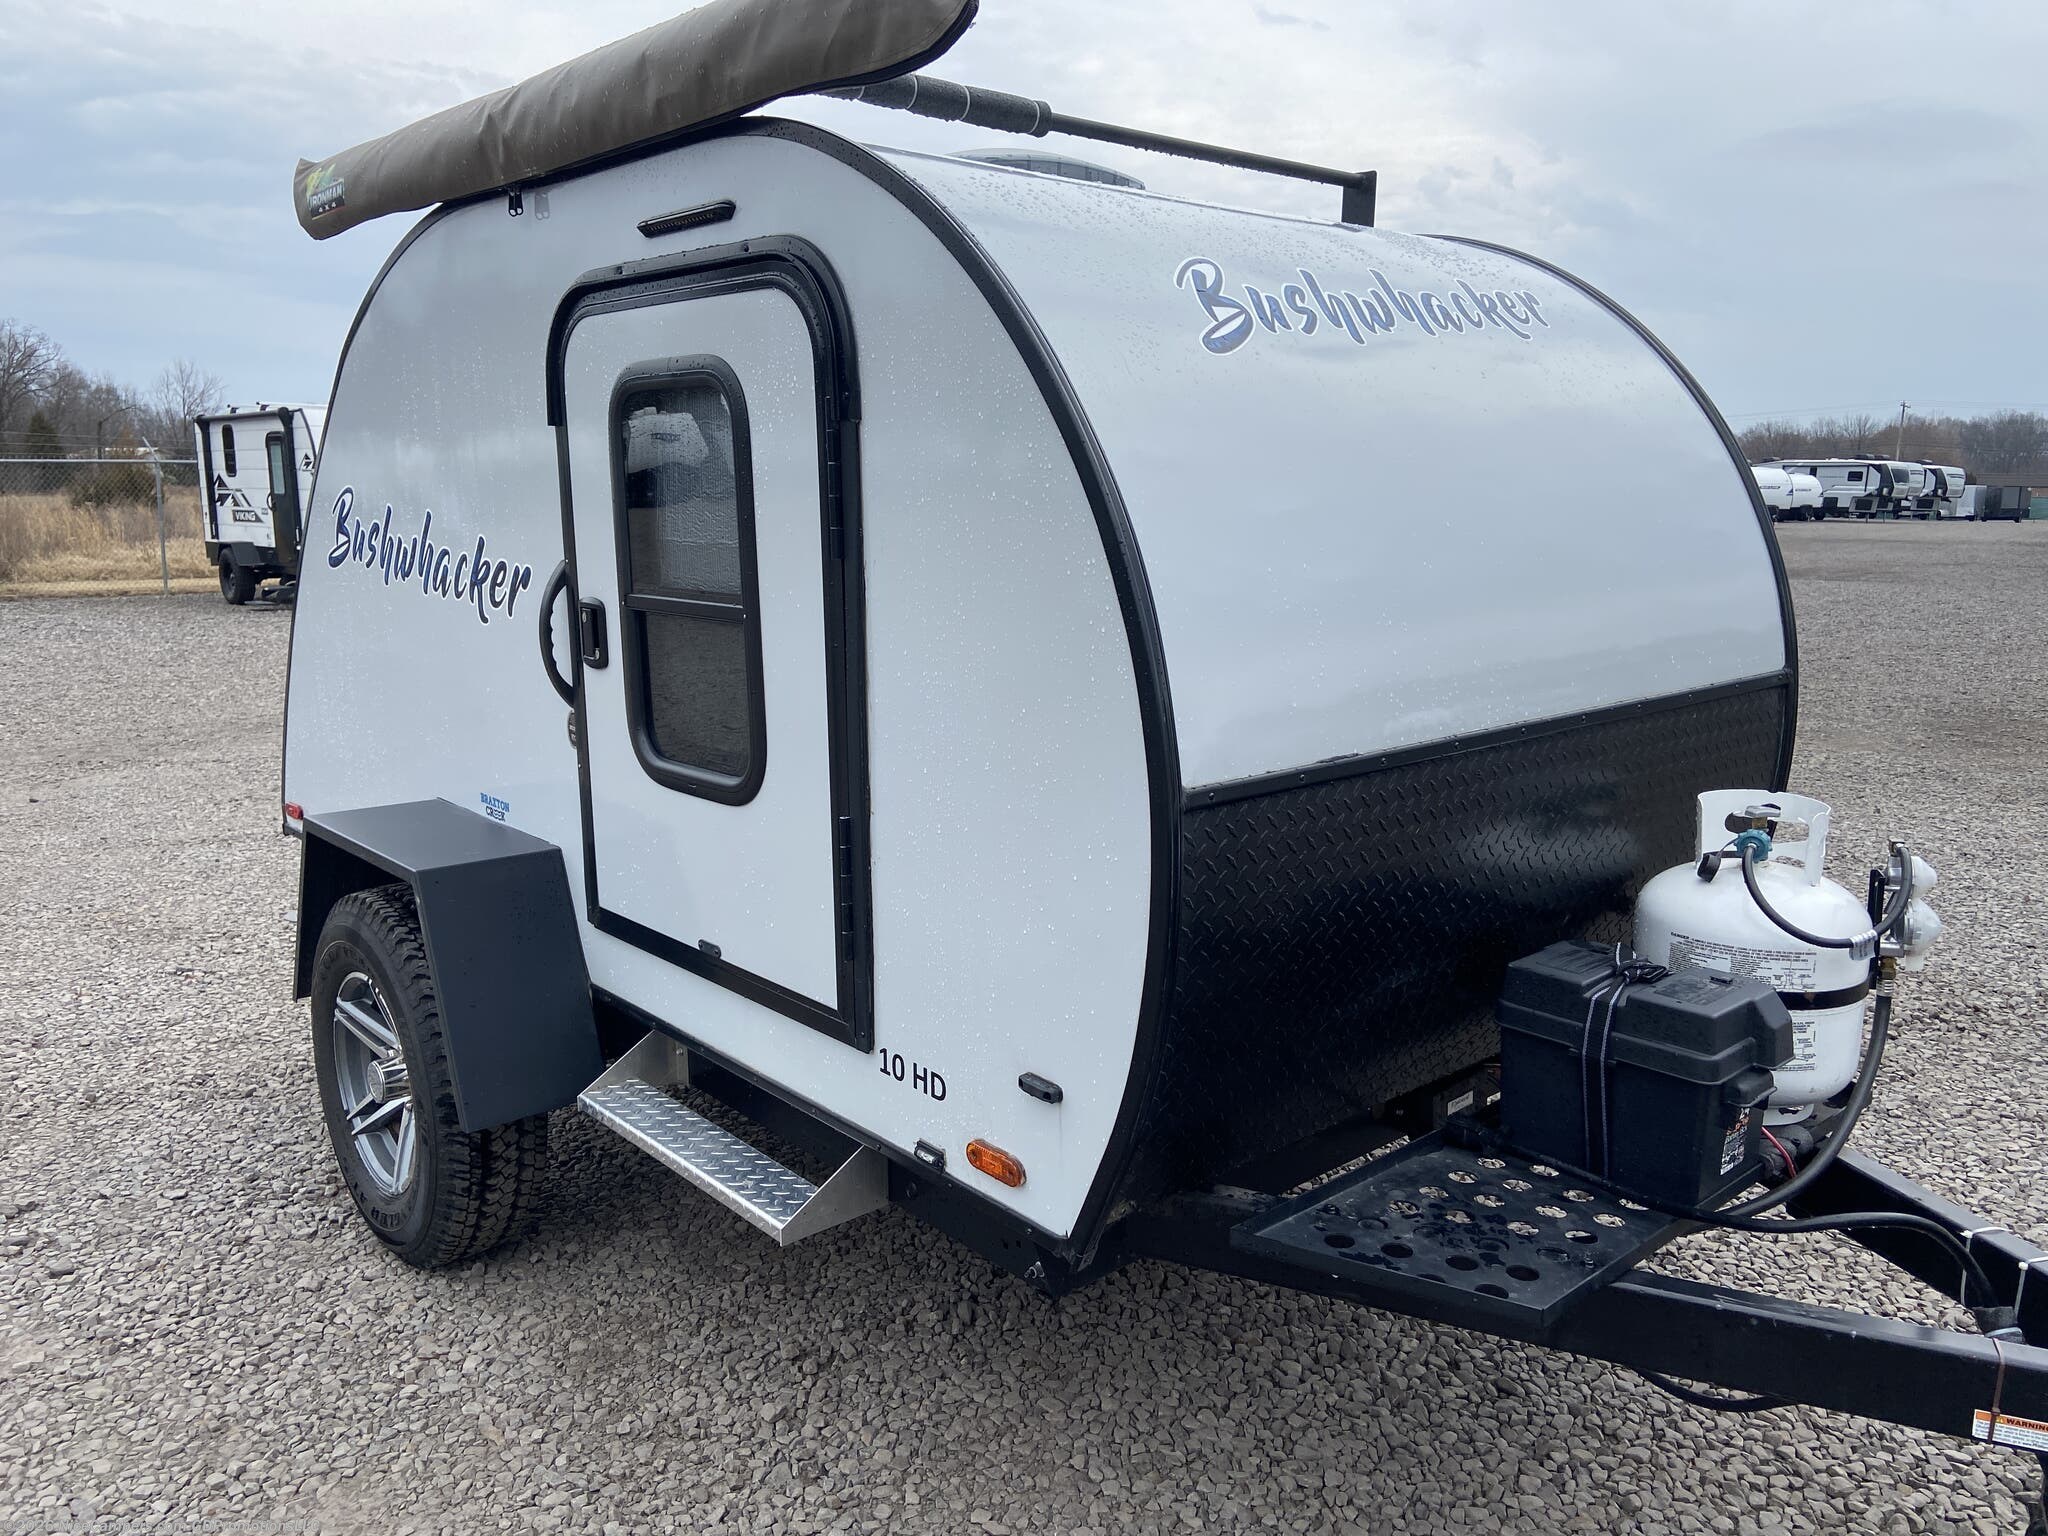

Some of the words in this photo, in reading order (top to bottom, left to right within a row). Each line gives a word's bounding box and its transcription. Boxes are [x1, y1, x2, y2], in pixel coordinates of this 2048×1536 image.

[308, 182, 344, 209] IRONMAN
[1174, 257, 1550, 355] Bushwhacker
[236, 511, 256, 521] VIKING
[328, 486, 532, 624] Bushwhacker
[480, 792, 510, 812] BRAXTON
[879, 1047, 906, 1082] 10
[912, 1062, 947, 1101] HD
